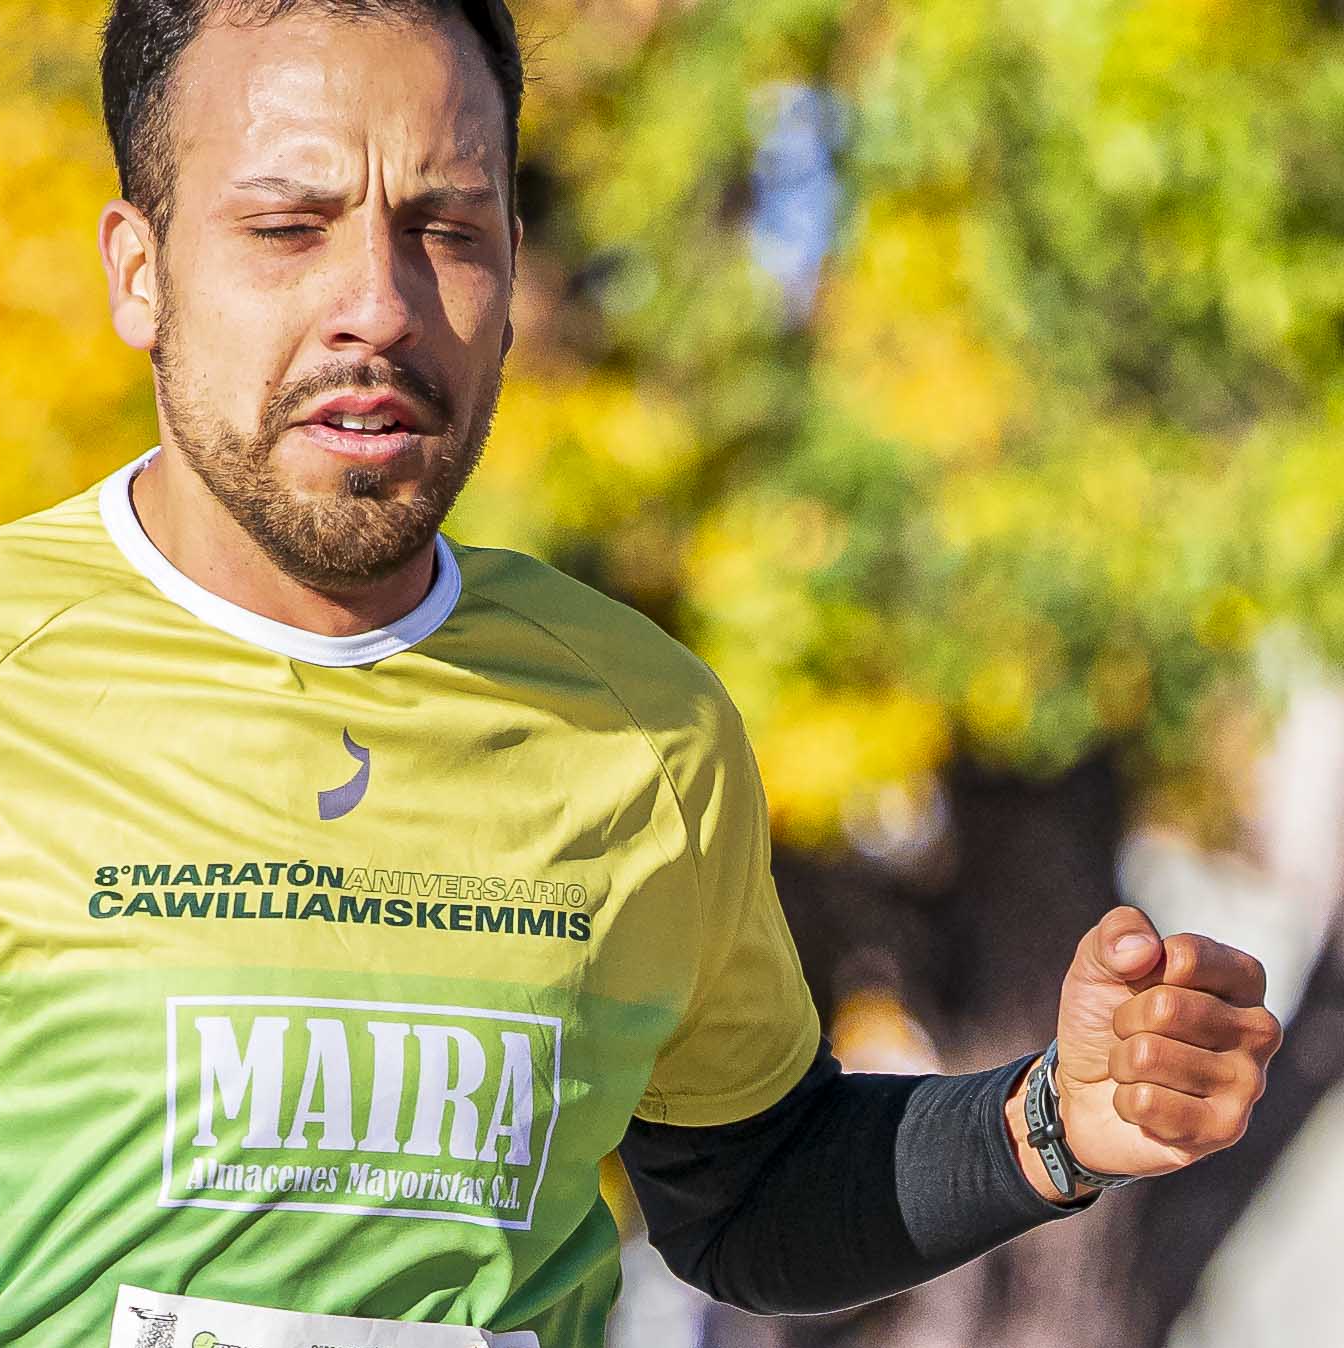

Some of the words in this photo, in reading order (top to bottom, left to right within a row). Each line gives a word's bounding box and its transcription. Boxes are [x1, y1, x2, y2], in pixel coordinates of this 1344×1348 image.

[342, 867, 588, 908] ANIVERSARIO
[88, 890, 592, 942] CAWILLIAMSKEMMIS
[192, 1015, 533, 1166] MAIRA
[186, 1157, 339, 1194] Almacenes
[344, 1163, 484, 1206] Mayoristas
